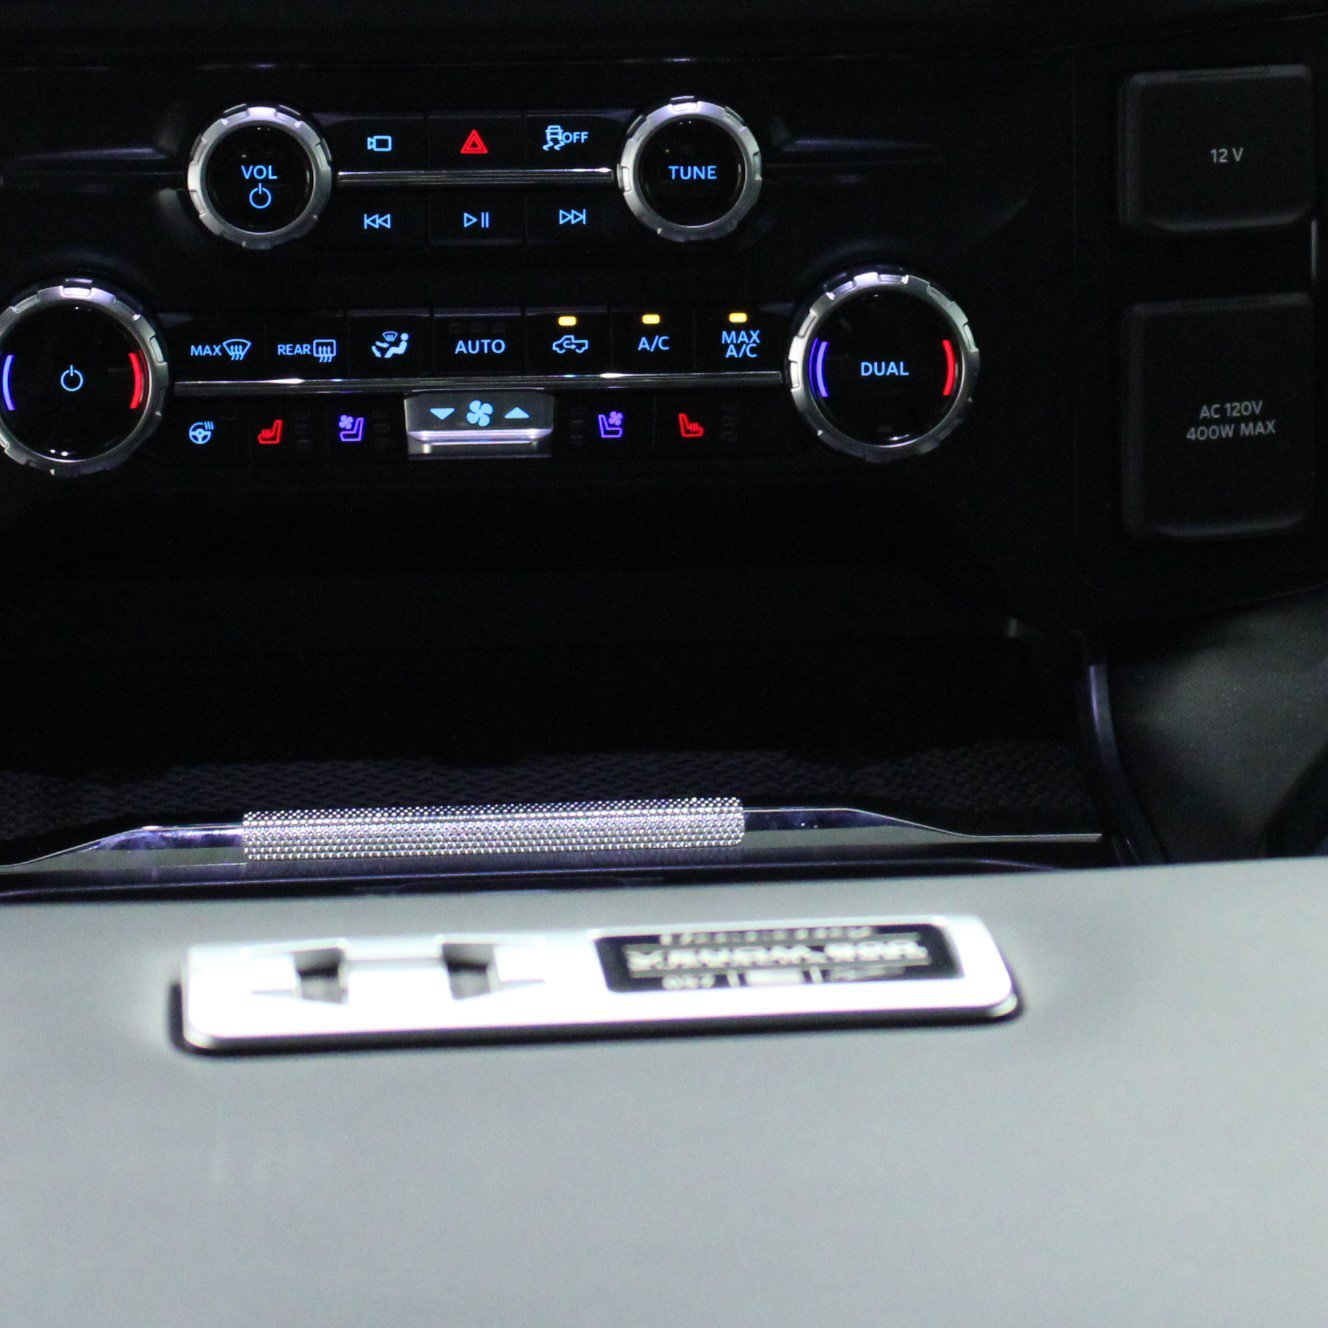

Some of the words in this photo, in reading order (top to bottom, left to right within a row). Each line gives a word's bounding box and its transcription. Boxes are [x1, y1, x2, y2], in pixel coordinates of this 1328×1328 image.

[563, 130, 588, 144] OFF
[1211, 148, 1229, 163] 12
[1232, 147, 1244, 162] V
[241, 165, 277, 180] VOL
[669, 165, 717, 181] TUNE
[637, 335, 670, 351] A/C
[721, 329, 761, 345] MAX
[190, 343, 221, 356] MAX
[277, 342, 311, 356] REAR
[455, 339, 506, 357] AUTO
[725, 343, 757, 359] A/C
[860, 361, 909, 377] DUAL
[1199, 404, 1221, 418] AC
[1225, 401, 1263, 417] 120V
[1186, 424, 1234, 441] 400W
[1240, 420, 1276, 436] MAX
